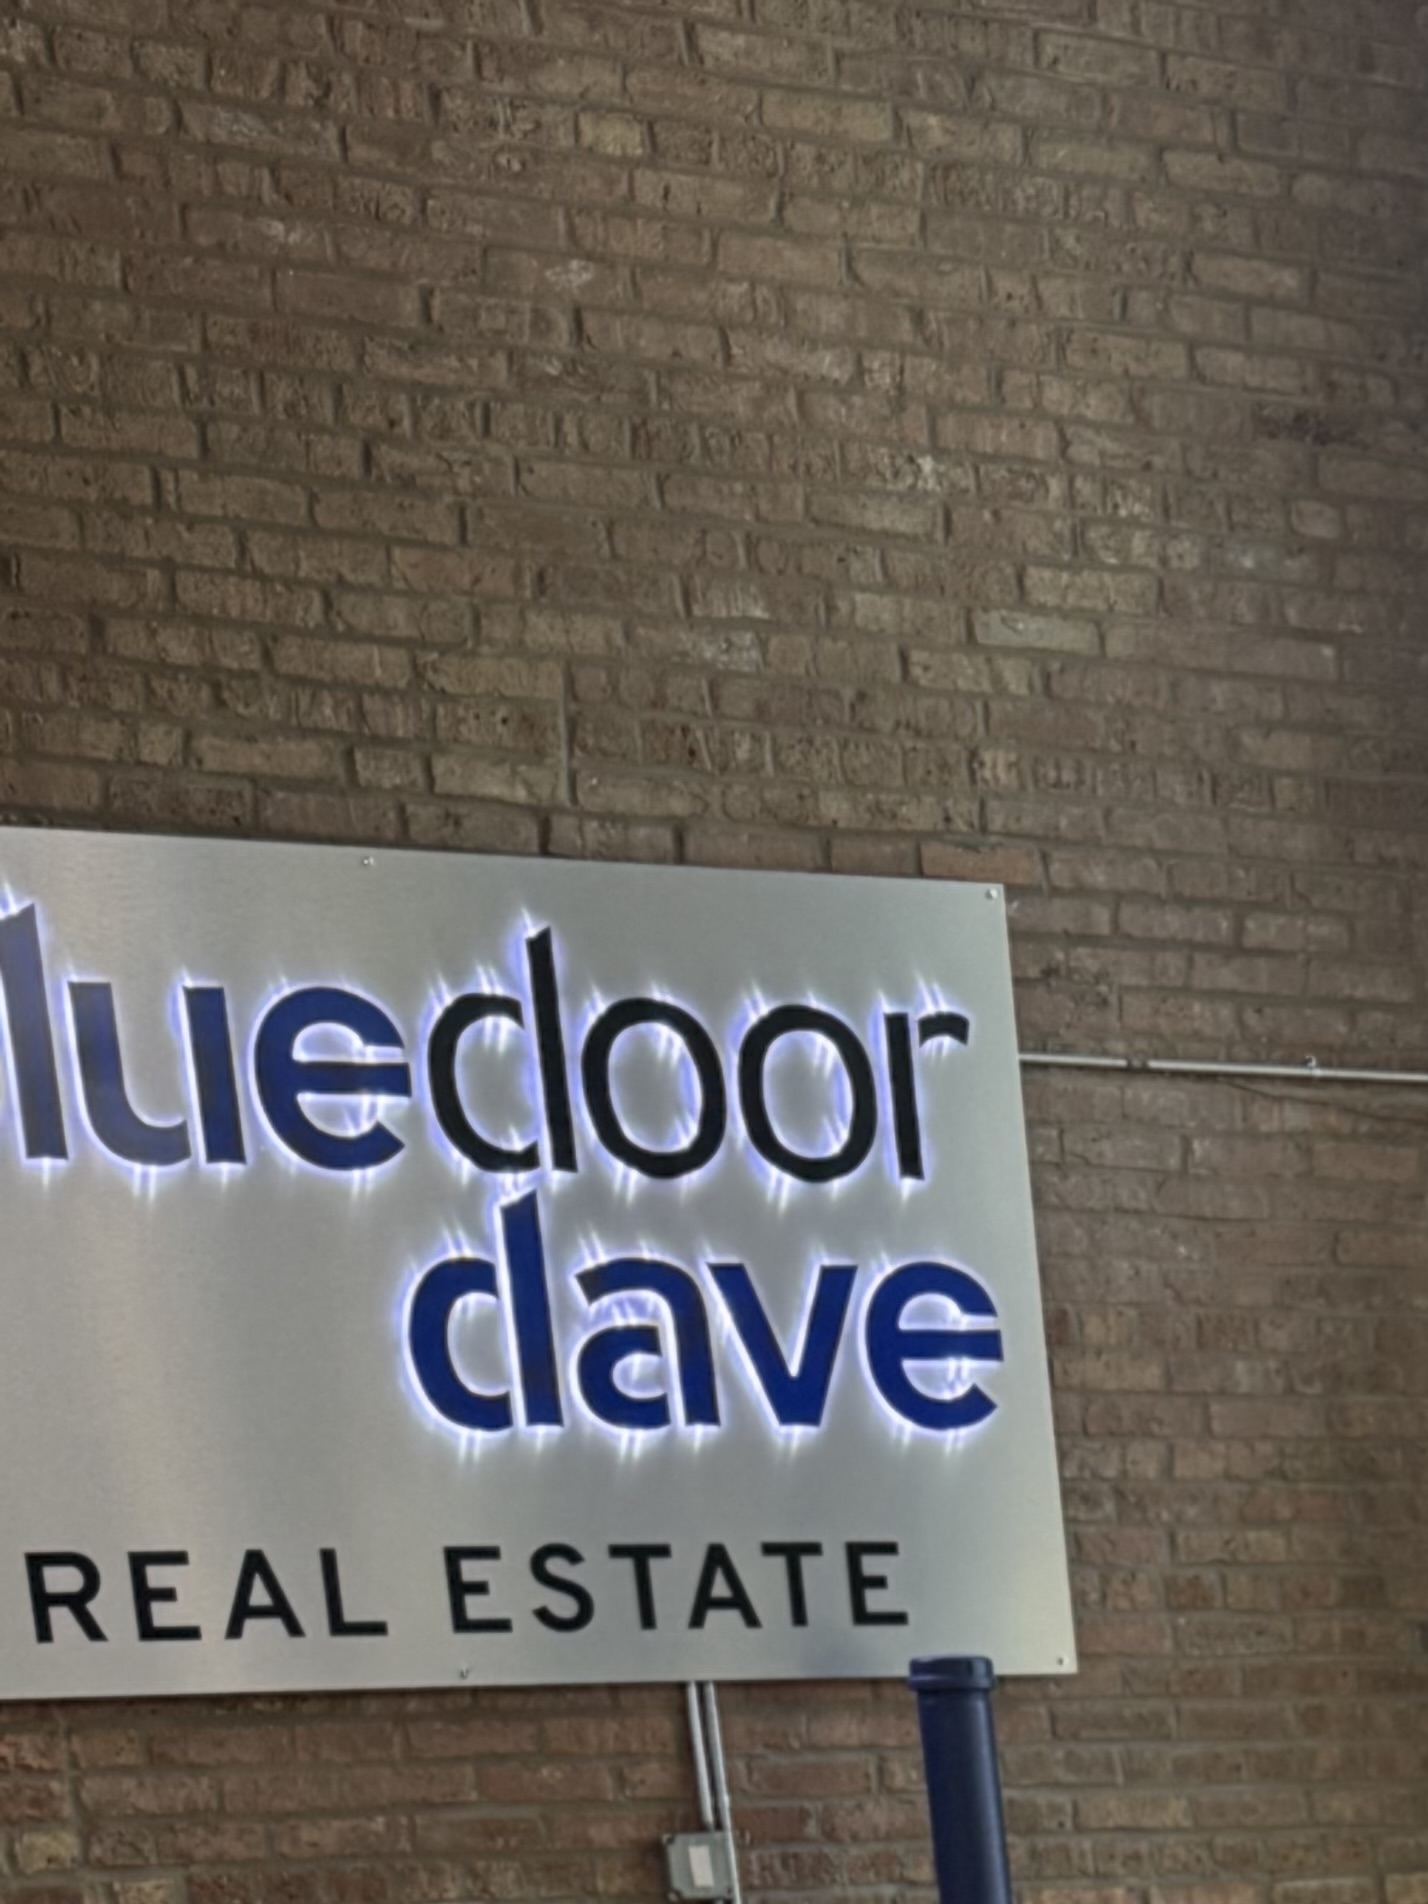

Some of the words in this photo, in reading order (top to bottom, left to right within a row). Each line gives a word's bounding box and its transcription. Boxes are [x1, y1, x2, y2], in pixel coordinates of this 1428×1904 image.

[407, 1189, 1004, 1433] dave
[24, 1547, 389, 1643] REAL
[443, 1542, 909, 1634] ESTATE
